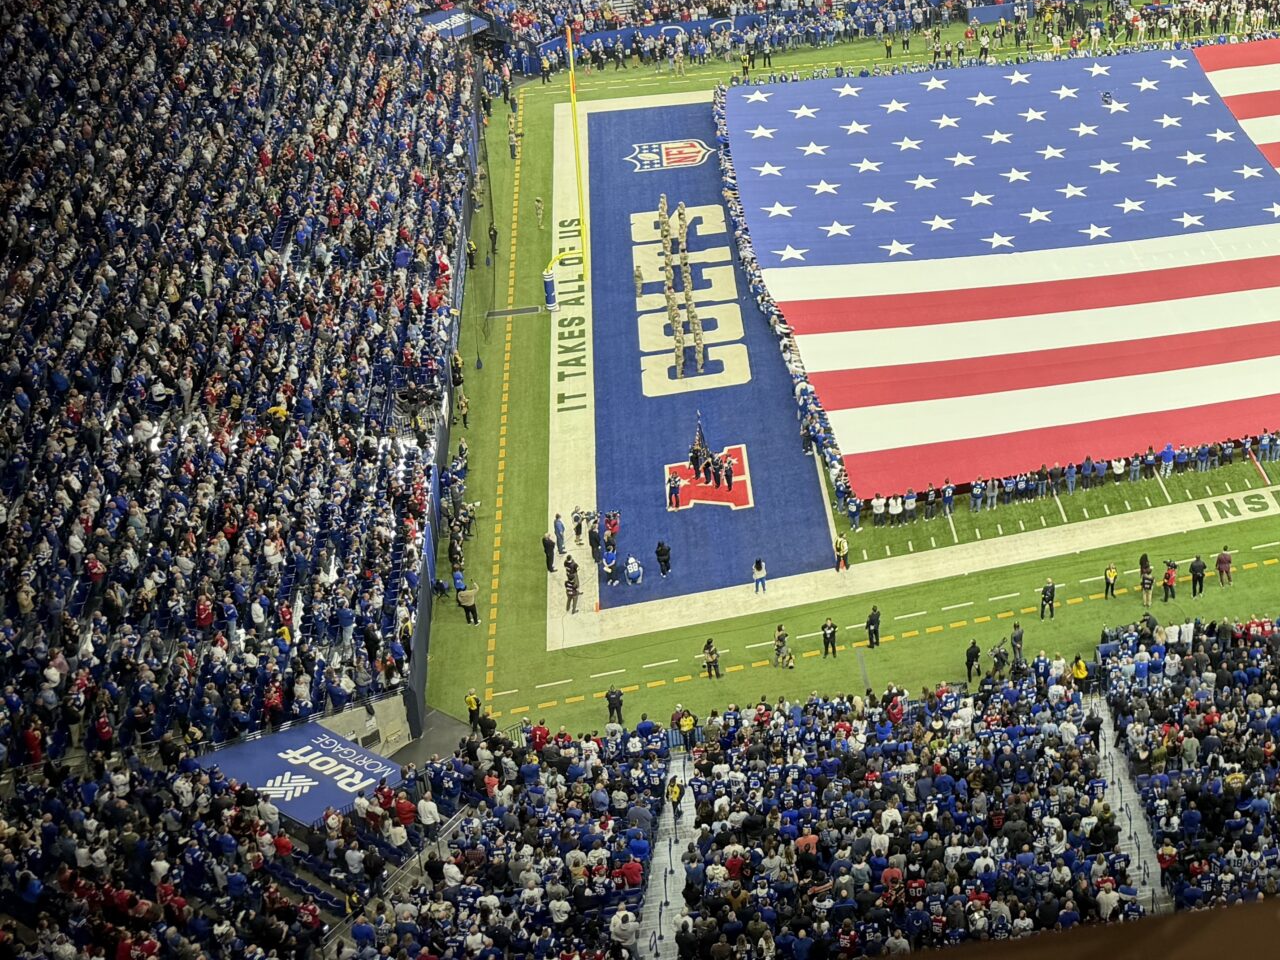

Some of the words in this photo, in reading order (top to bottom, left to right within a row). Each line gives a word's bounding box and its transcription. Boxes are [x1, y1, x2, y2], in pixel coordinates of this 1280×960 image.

[664, 141, 702, 165] NFL
[558, 218, 582, 240] US
[558, 246, 585, 267] OF
[558, 273, 585, 306] ALL
[630, 204, 752, 398] COLTS
[557, 316, 587, 382] TAKES
[557, 393, 587, 413] IT
[311, 733, 396, 778] MORTGAGE
